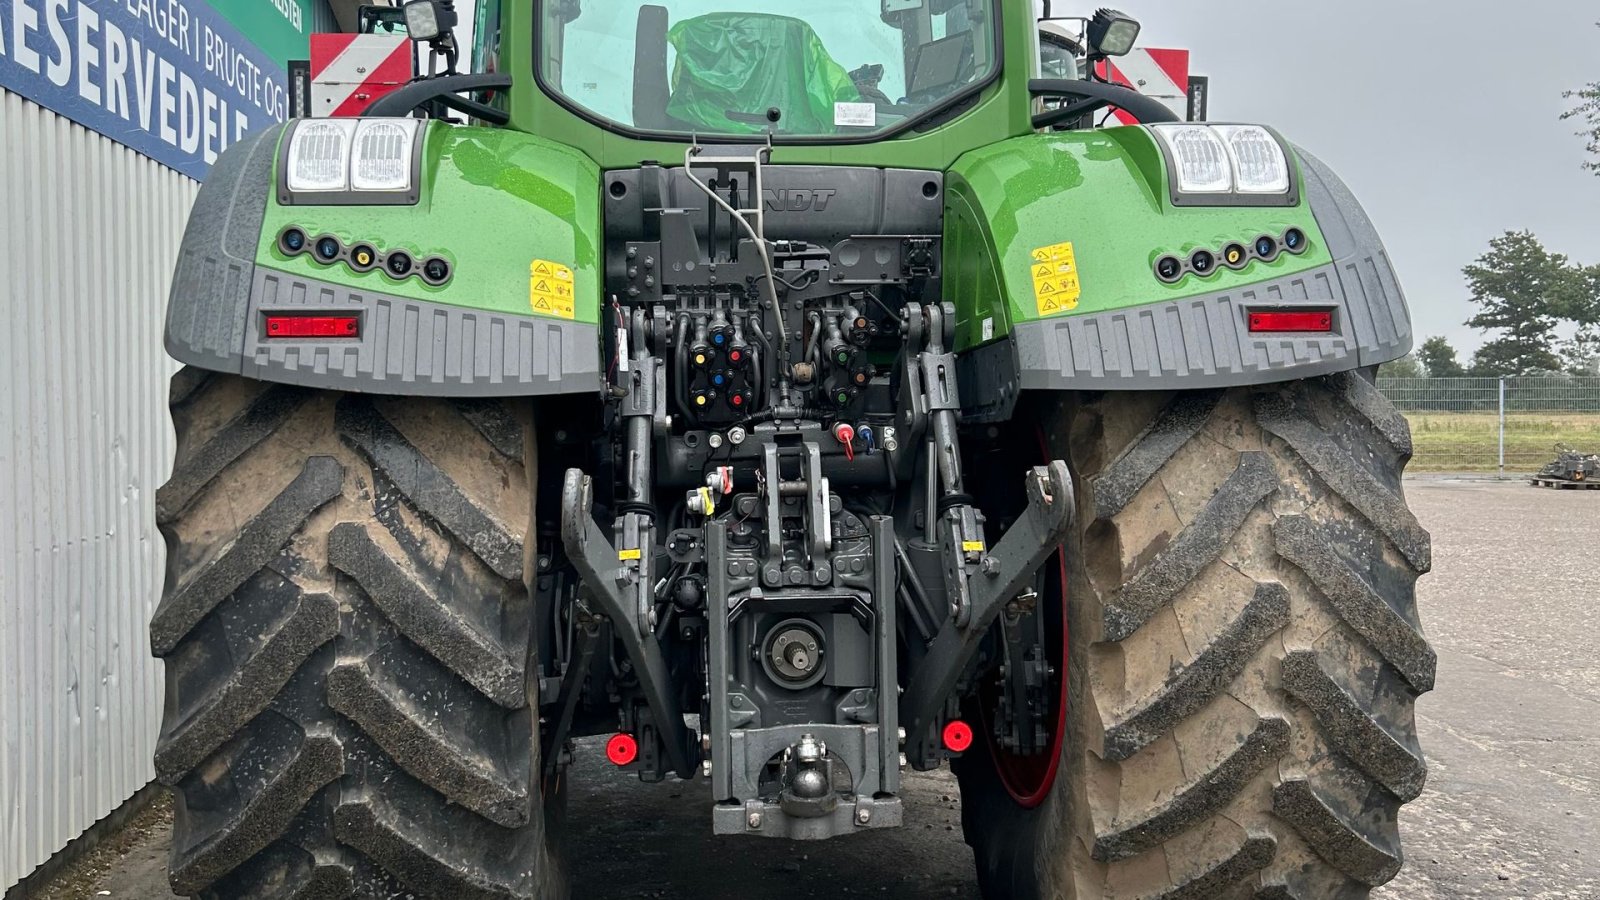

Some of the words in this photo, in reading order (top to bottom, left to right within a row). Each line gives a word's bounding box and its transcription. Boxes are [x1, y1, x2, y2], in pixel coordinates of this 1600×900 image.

[270, 0, 303, 34] ISTEN
[0, 0, 248, 165] ESERVEDEL
[127, 0, 190, 55] AGER
[205, 25, 261, 107] BRUGTE
[264, 76, 283, 124] OG
[714, 189, 836, 211] NDT
